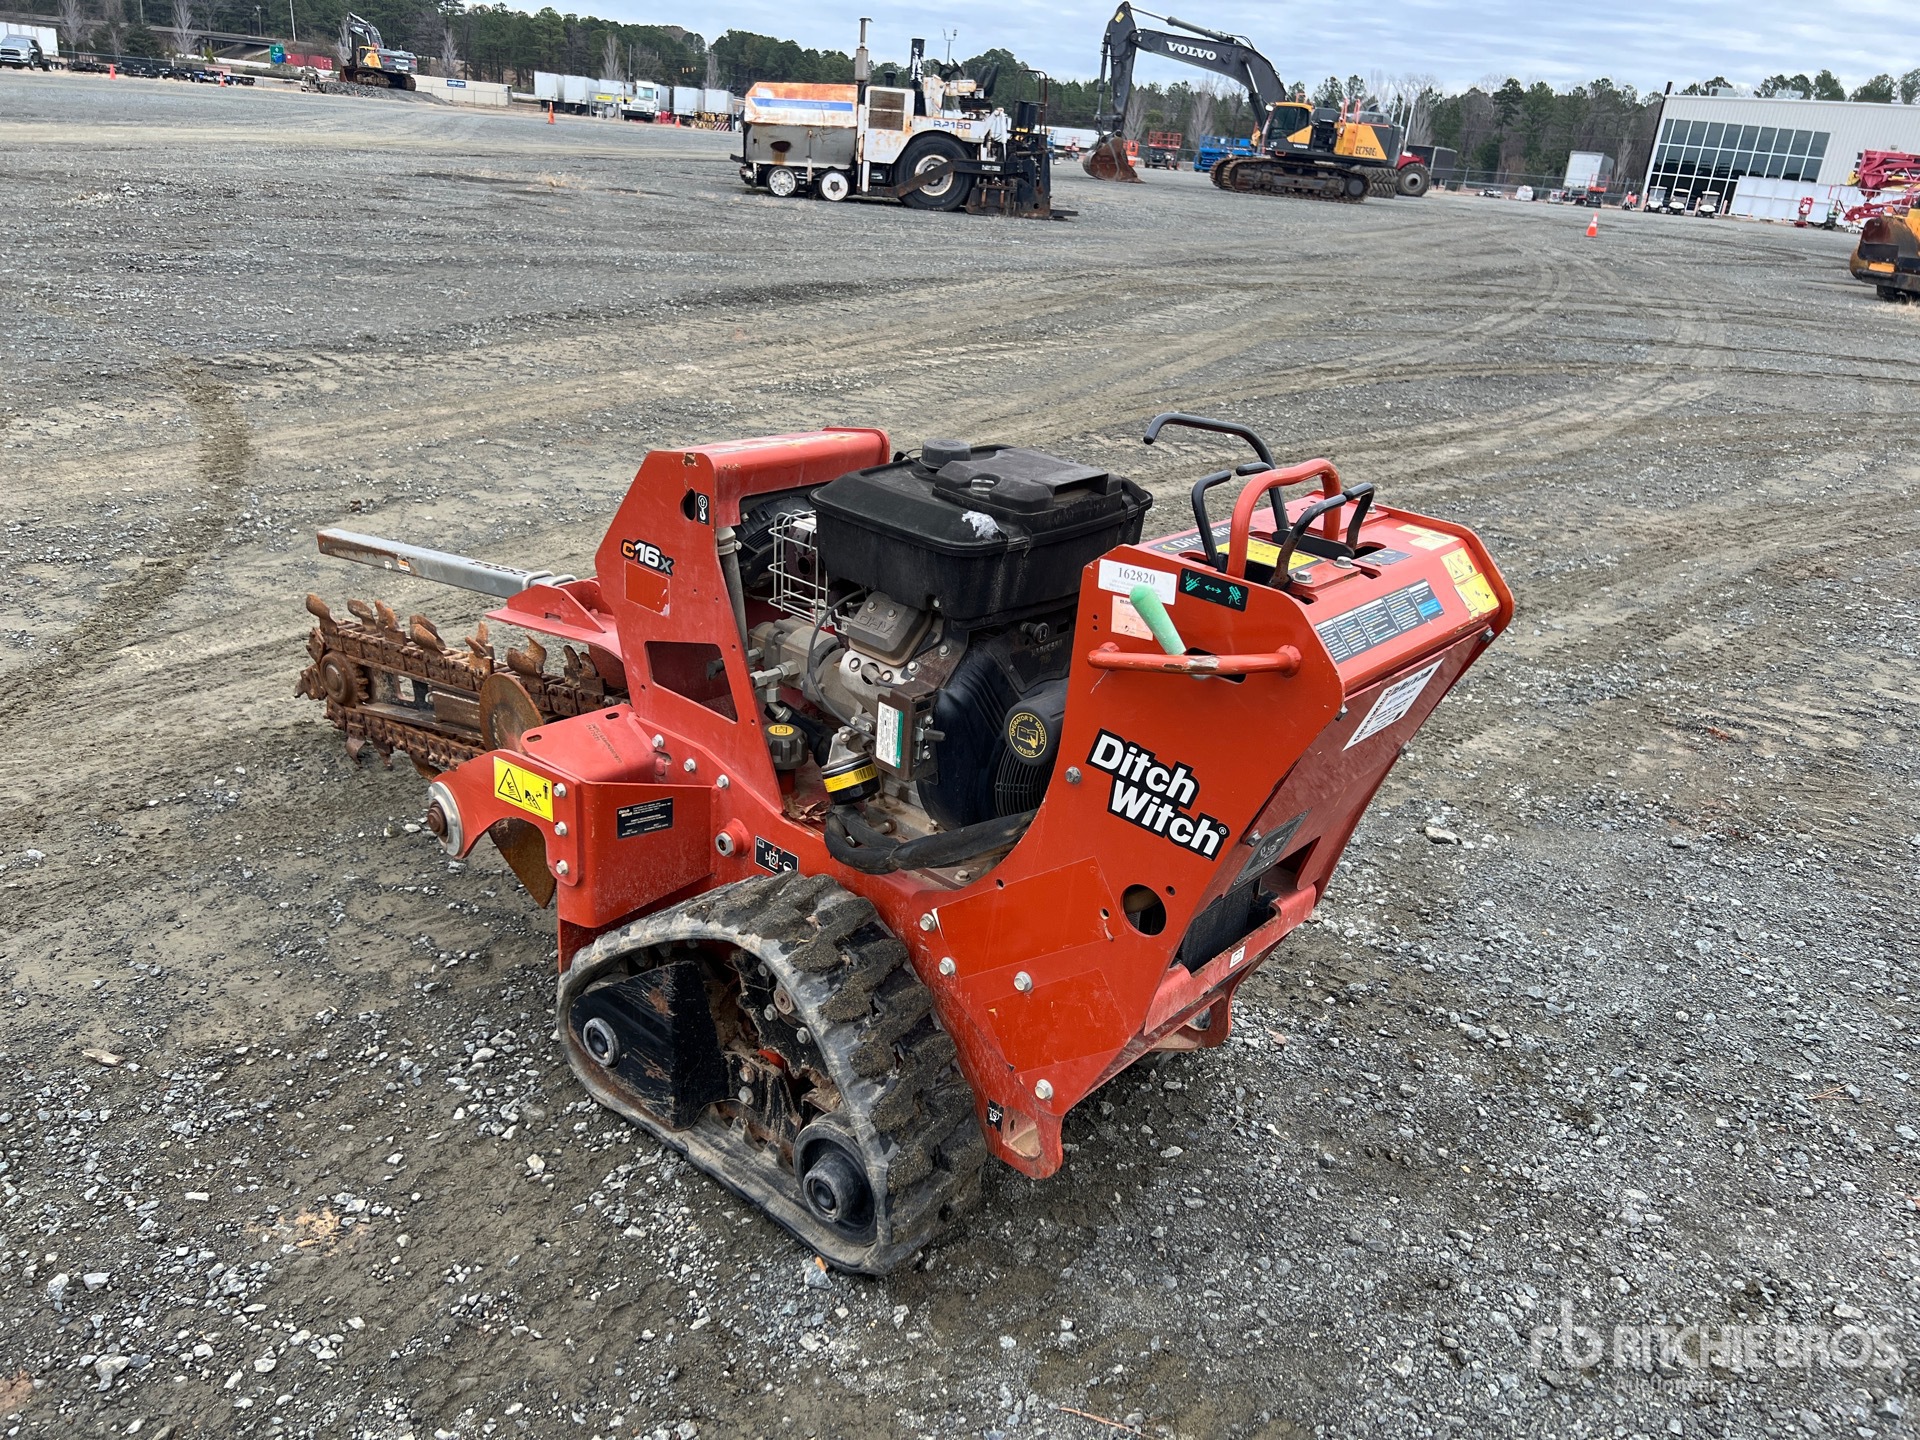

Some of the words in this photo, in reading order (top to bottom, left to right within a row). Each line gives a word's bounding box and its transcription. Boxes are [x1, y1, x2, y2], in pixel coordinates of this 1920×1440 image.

[1166, 41, 1217, 61] VOLVO
[1118, 567, 1156, 584] 162820
[1035, 721, 1045, 746] MANUAL
[1017, 744, 1036, 756] INSIDE
[1090, 733, 1196, 805] Ditch
[1111, 779, 1220, 856] Witch
